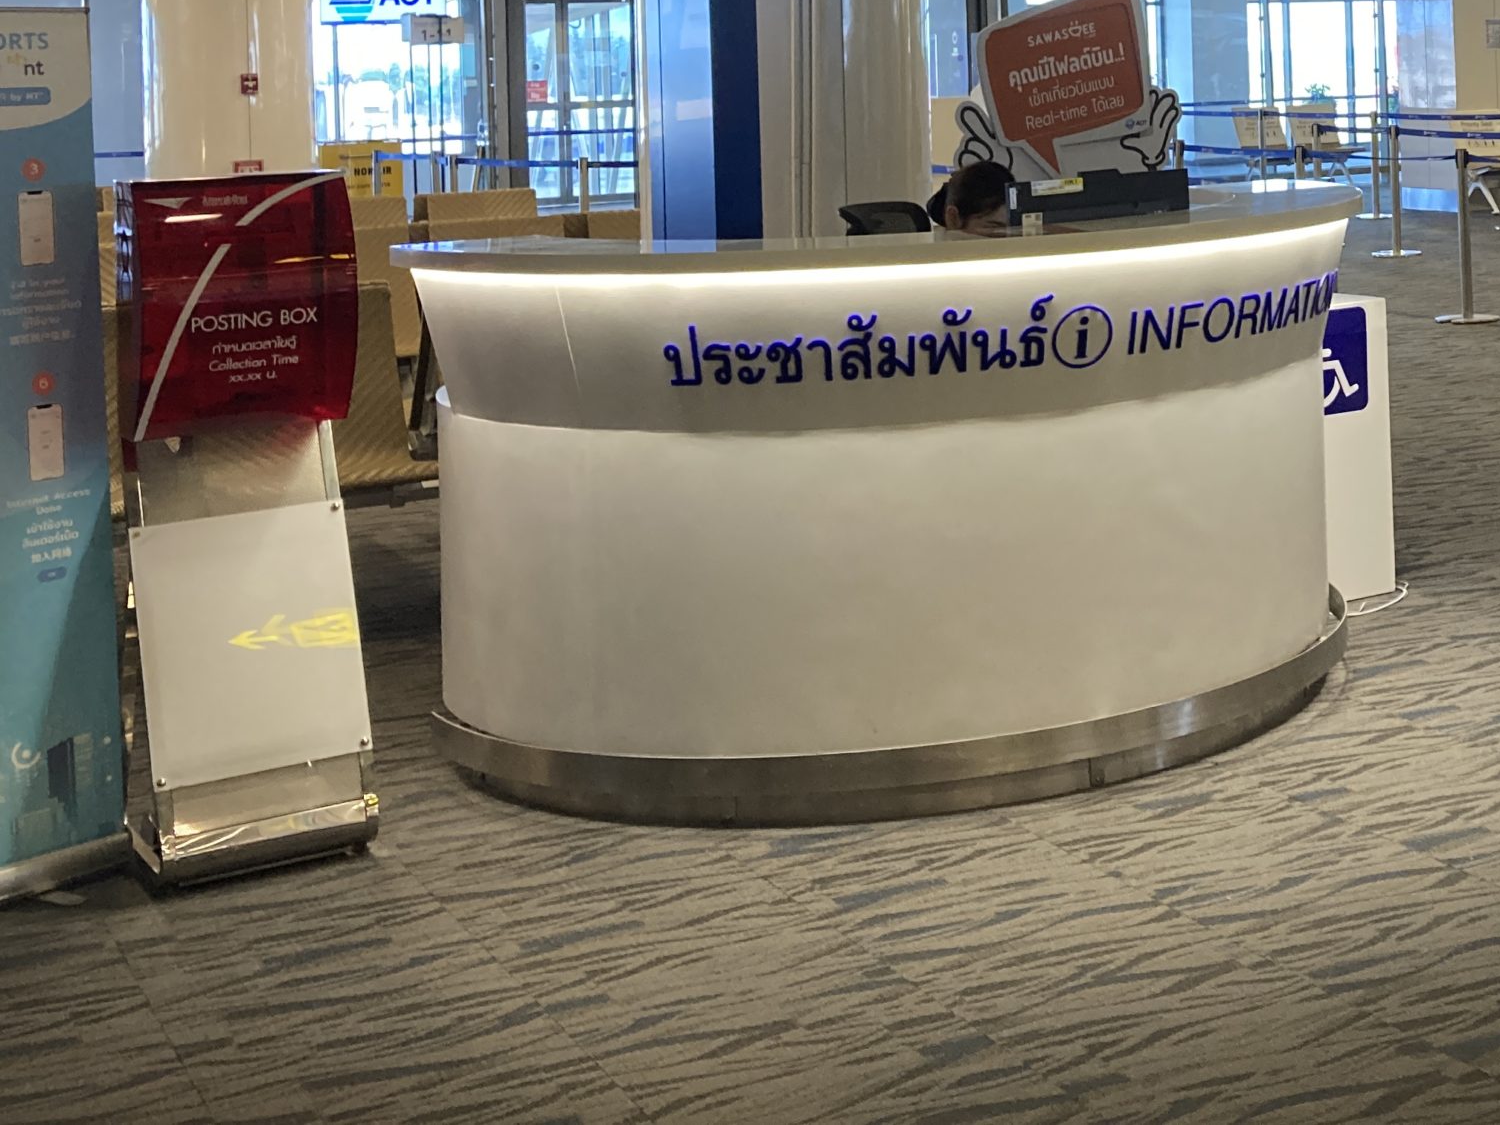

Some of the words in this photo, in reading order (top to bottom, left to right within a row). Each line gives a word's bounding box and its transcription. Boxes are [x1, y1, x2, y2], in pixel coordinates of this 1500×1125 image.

[1026, 101, 1087, 131] Real-time
[30, 163, 38, 175] 3
[191, 311, 273, 333] POSTING
[281, 307, 318, 325] BOX
[663, 294, 1054, 387] ประชาสัมพันธ์
[208, 357, 267, 372] Collection
[272, 355, 299, 365] Time
